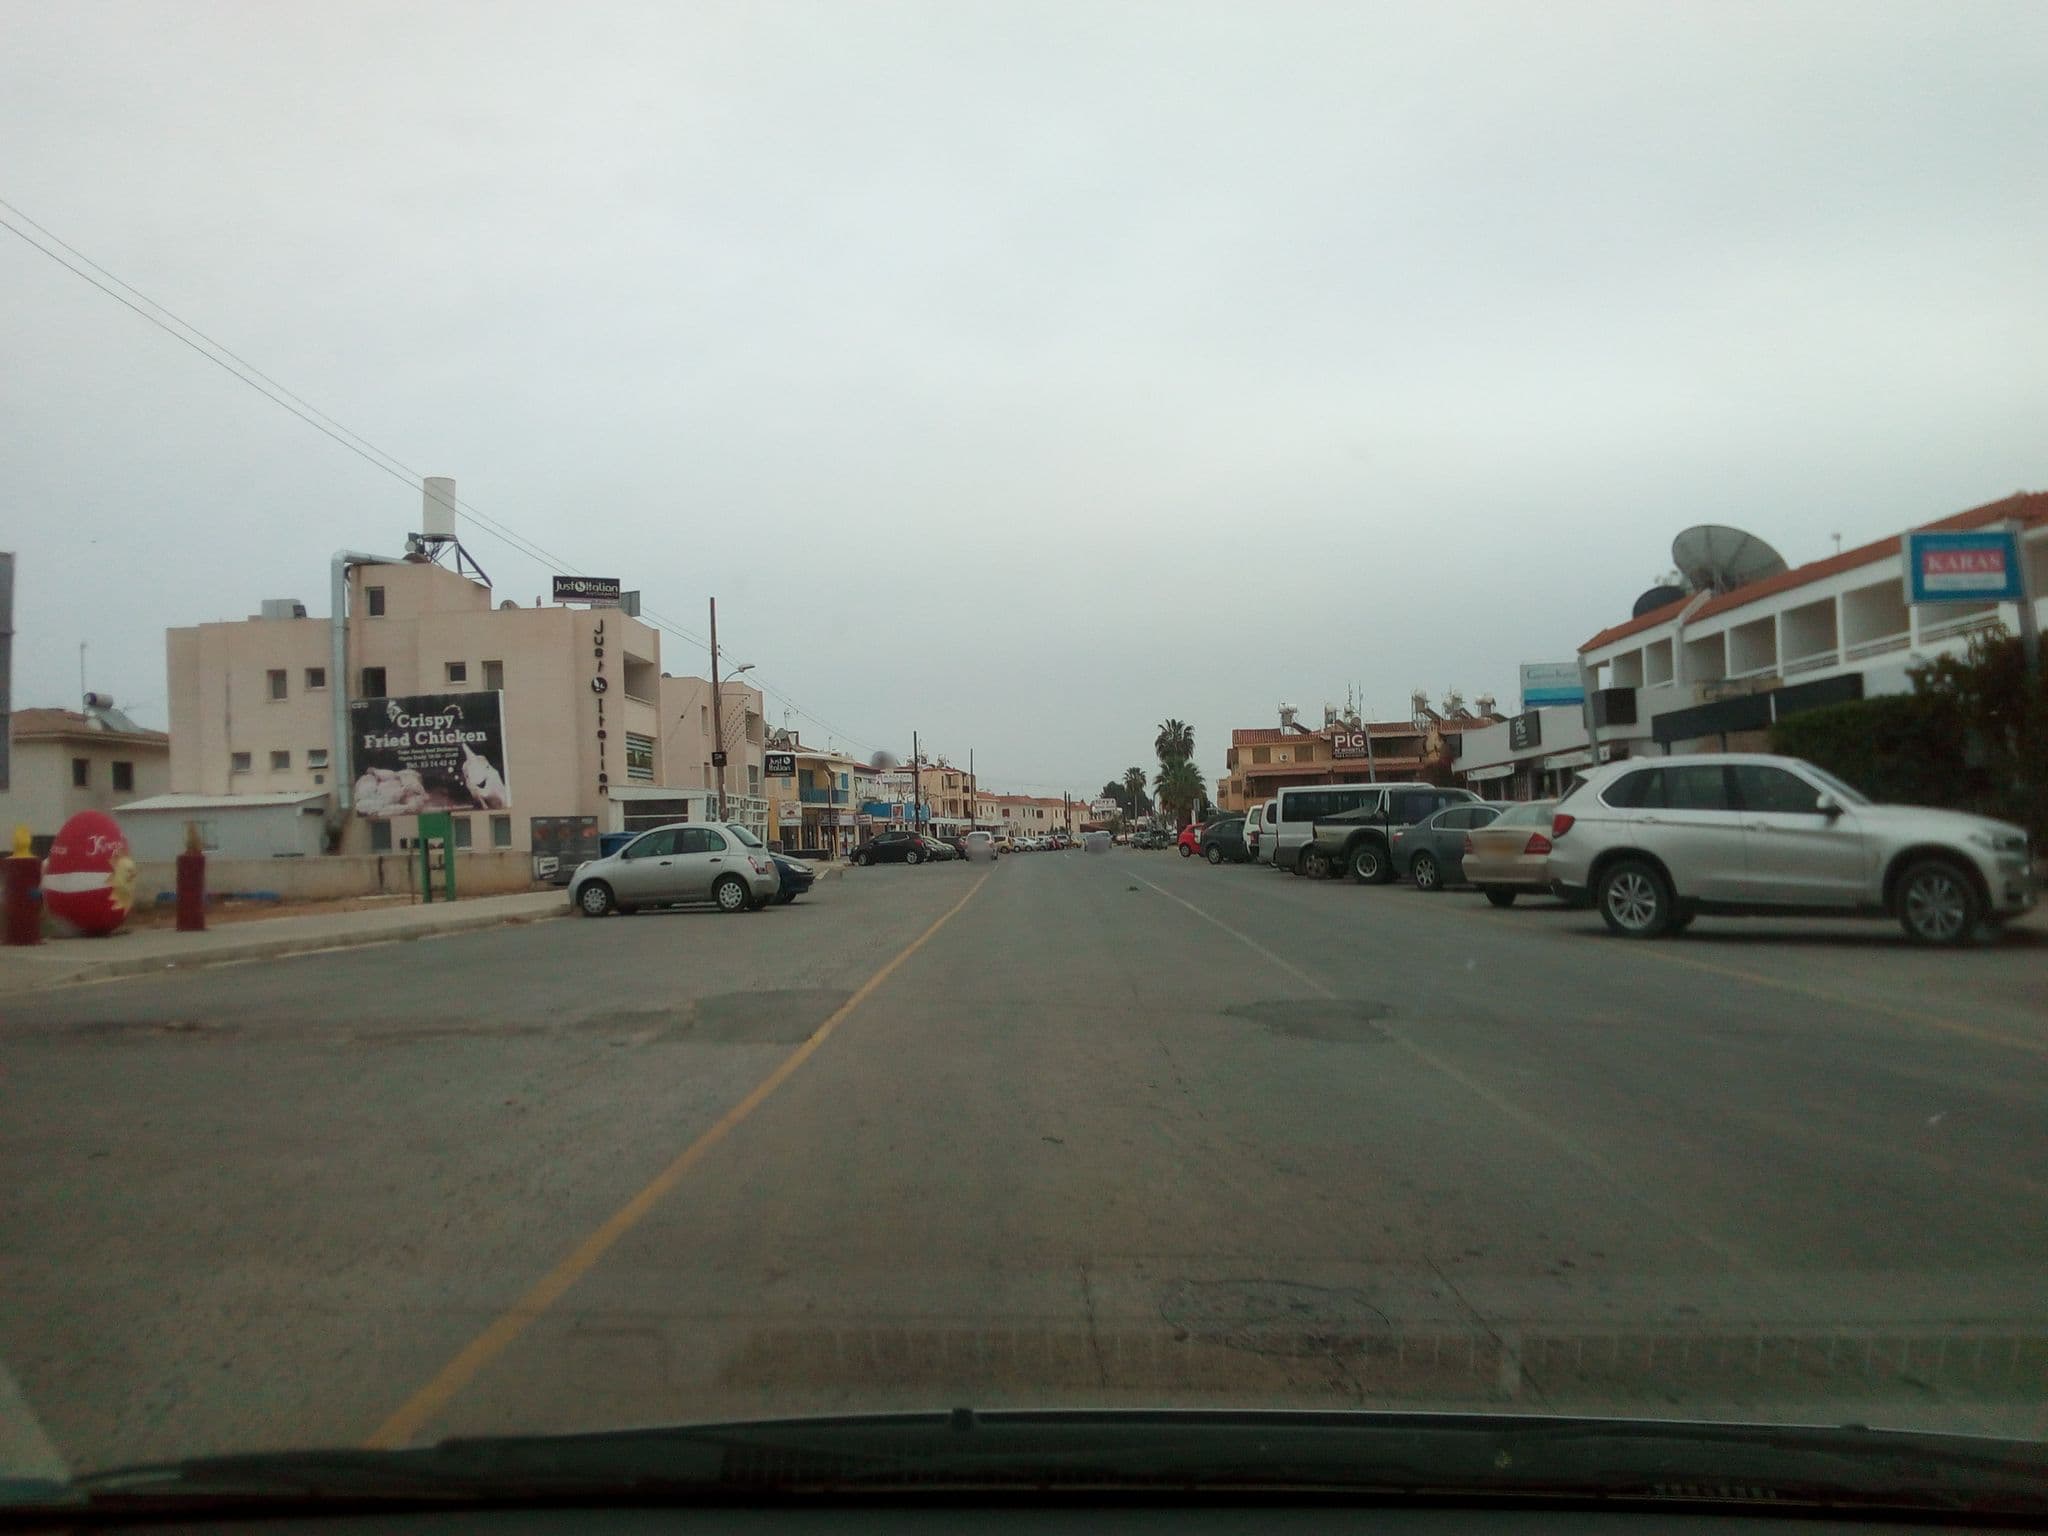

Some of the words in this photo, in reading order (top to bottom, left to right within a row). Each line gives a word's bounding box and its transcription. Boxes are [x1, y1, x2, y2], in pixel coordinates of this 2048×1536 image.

[1928, 553, 2000, 570] KARAS
[555, 580, 575, 592] Just
[585, 580, 618, 593] Italian
[397, 713, 455, 729] Crispy
[364, 732, 411, 748] Fried
[415, 729, 488, 745] Chicken
